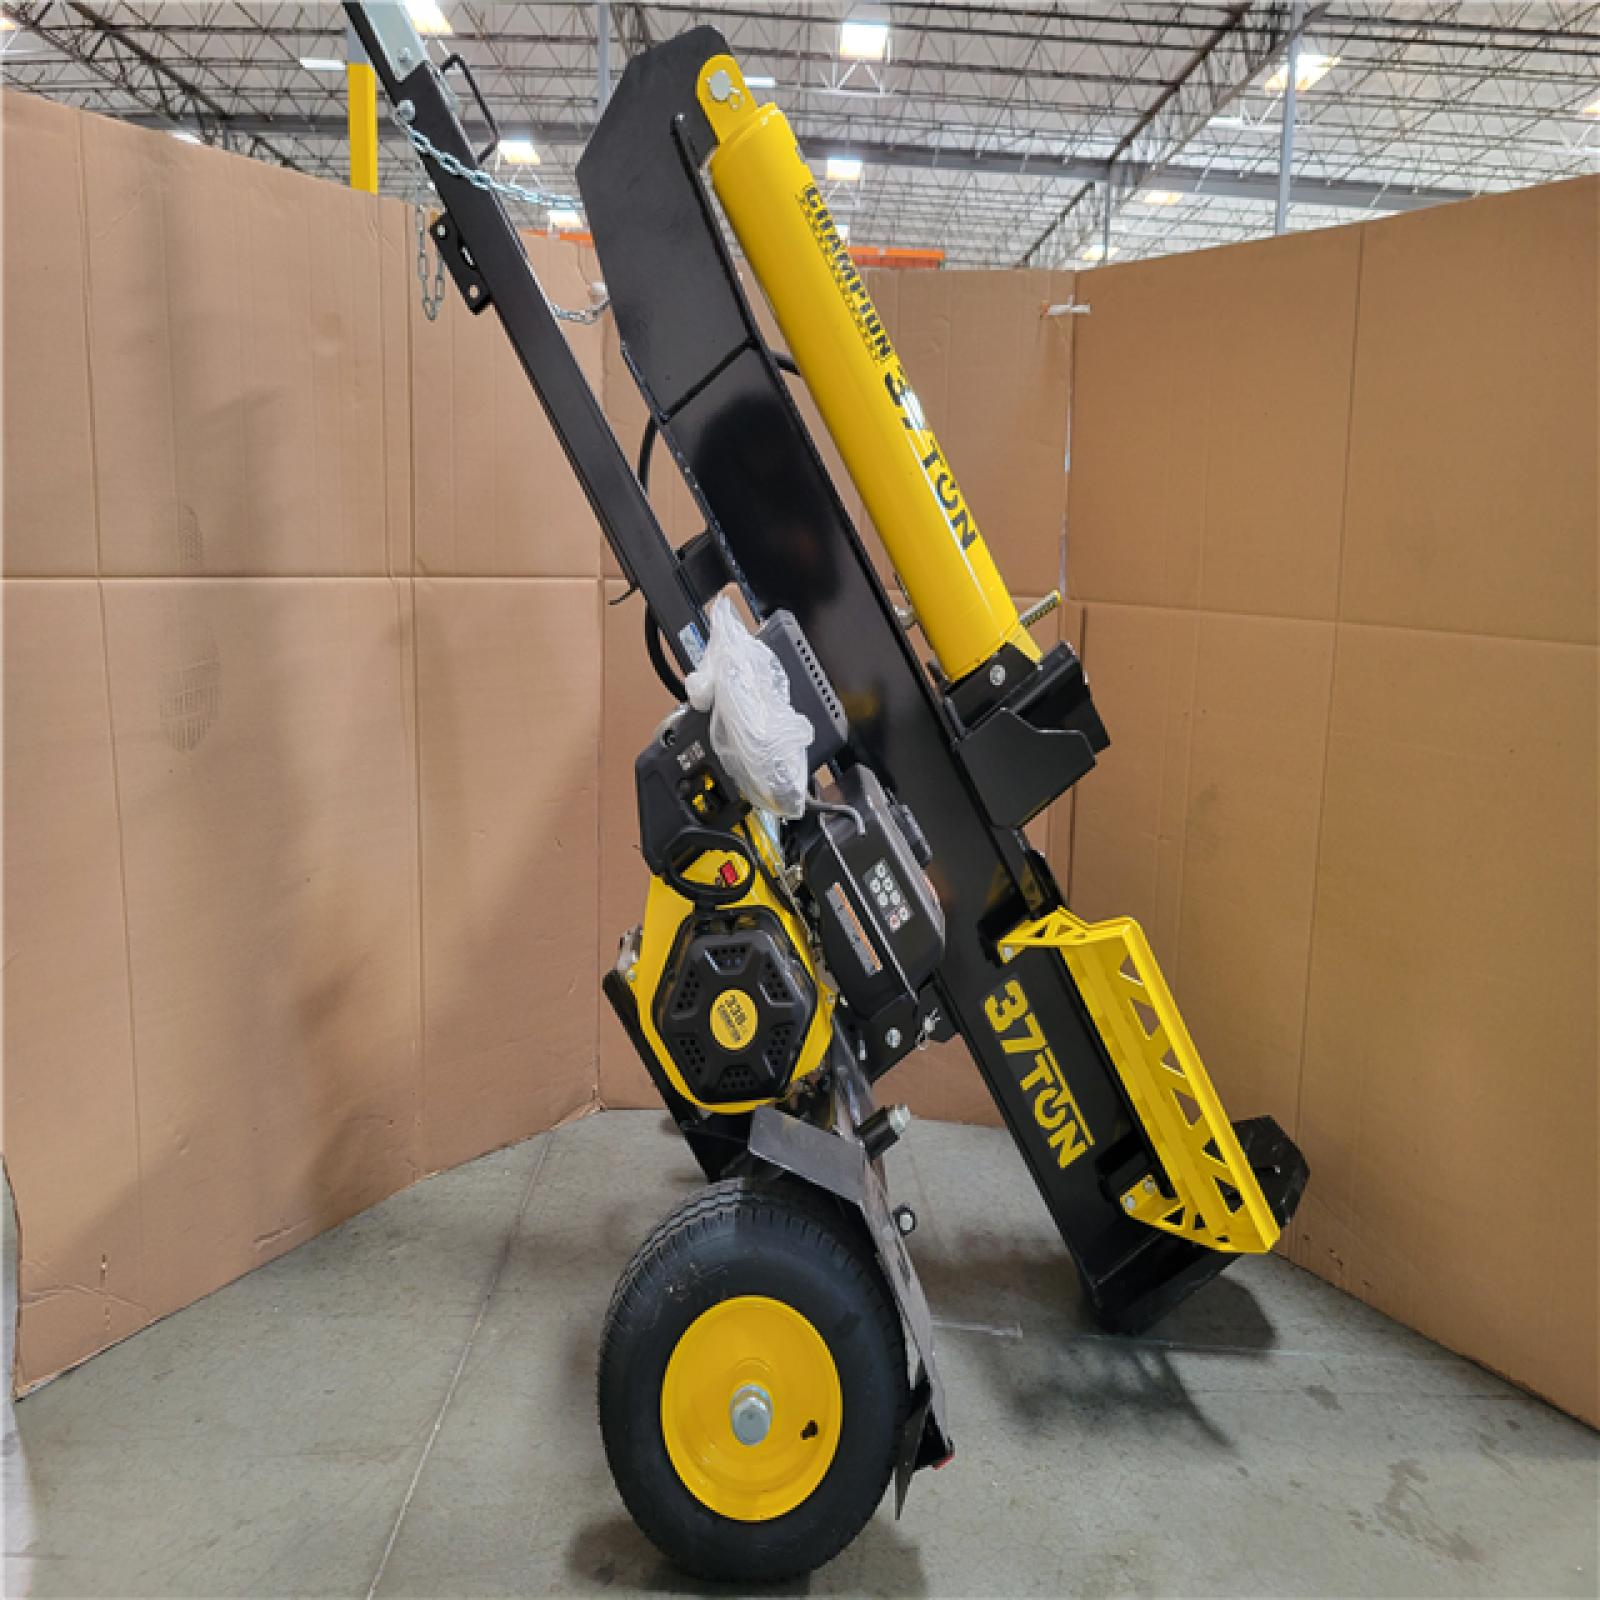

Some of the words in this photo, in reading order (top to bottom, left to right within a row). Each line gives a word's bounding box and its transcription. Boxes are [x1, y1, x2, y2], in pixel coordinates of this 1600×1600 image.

[805, 186, 891, 357] CHAMPION
[922, 440, 978, 551] TON
[985, 980, 1047, 1053] 37
[1020, 1048, 1094, 1168] TON
